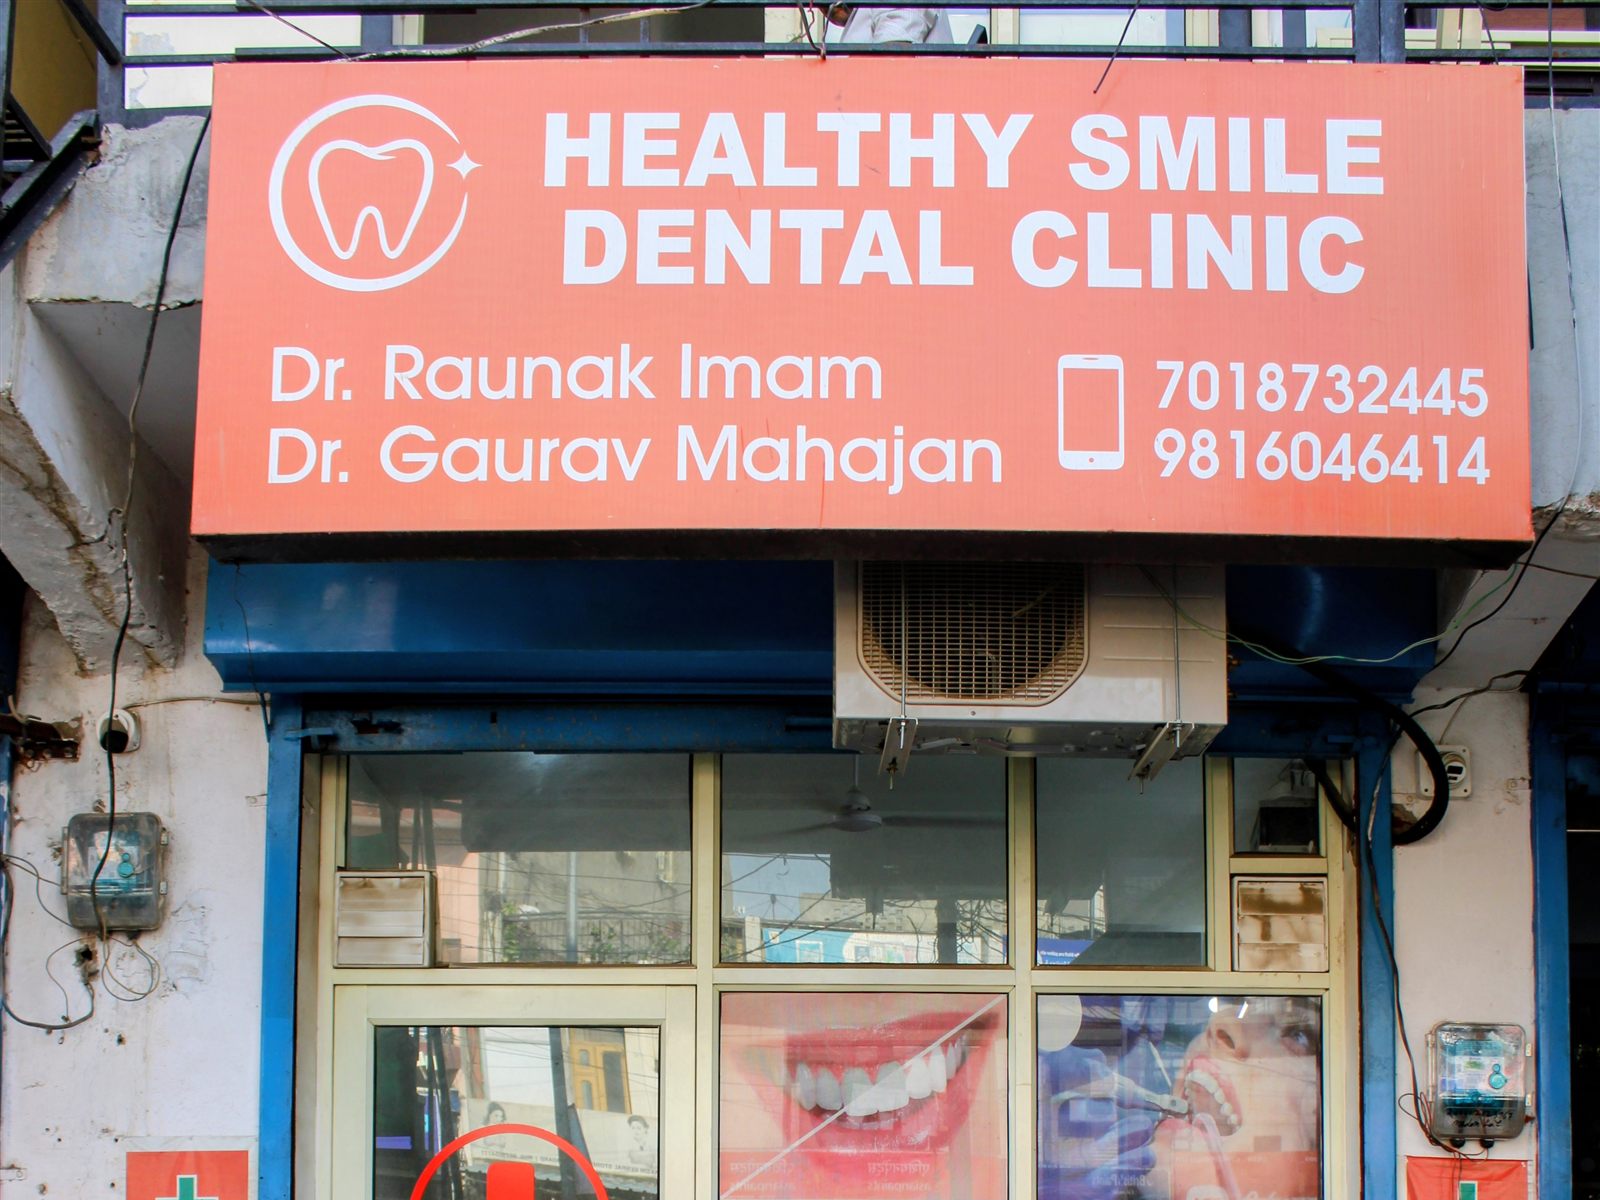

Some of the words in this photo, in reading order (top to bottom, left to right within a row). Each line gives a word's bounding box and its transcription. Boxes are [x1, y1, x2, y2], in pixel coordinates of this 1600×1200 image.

[543, 112, 1034, 189] HEALTHY
[1068, 113, 1384, 195] SMILE
[562, 208, 975, 286] DENTAL
[1011, 210, 1365, 294] CLINIC
[271, 346, 352, 402] Dr.
[384, 343, 656, 401] Raunak
[680, 343, 882, 400] Imam
[1156, 360, 1489, 418] 7018732445
[267, 427, 349, 484] Dr.
[379, 424, 652, 483] Gaurav
[677, 424, 1003, 495] Mahajan
[1153, 427, 1490, 485] 9816046414
